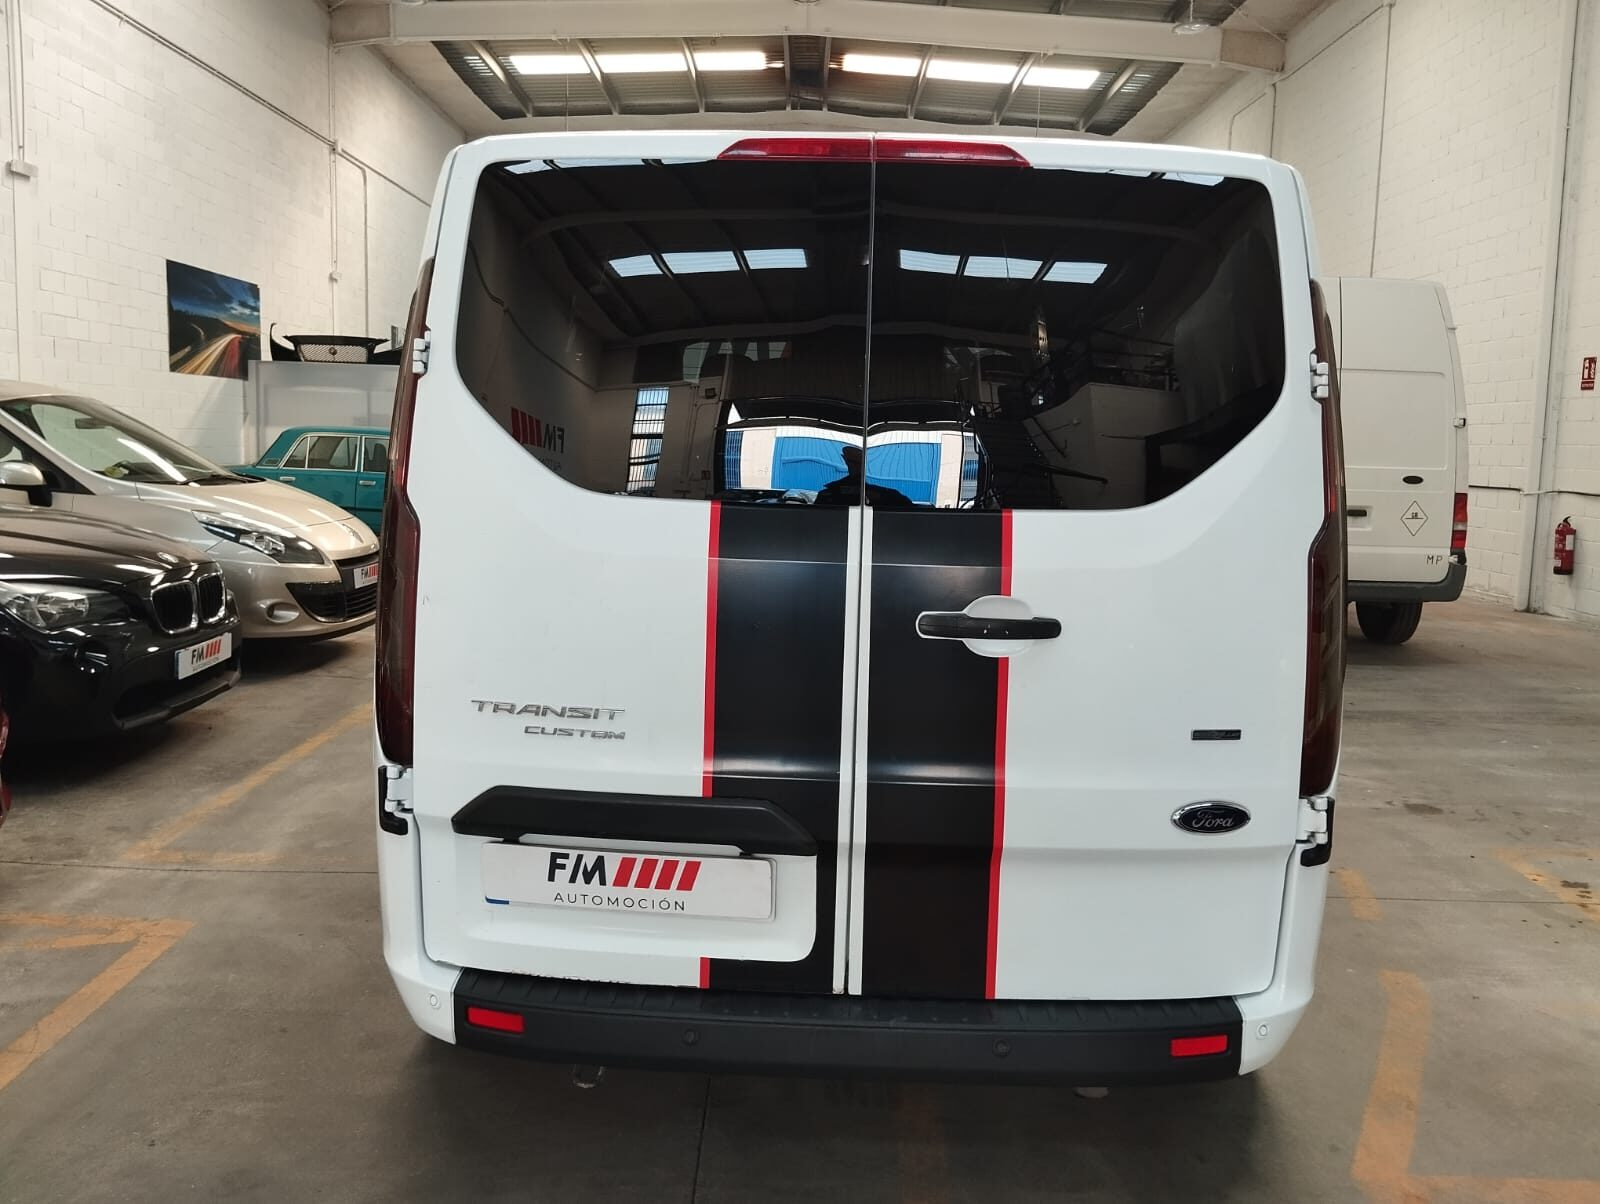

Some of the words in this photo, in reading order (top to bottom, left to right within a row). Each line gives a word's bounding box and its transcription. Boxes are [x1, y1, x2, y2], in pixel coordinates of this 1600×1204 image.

[191, 646, 204, 664] FM
[471, 700, 625, 720] TRANSIT
[524, 725, 625, 740] CUSTOM
[1192, 809, 1234, 828] Ford
[547, 851, 607, 886] FM
[553, 892, 686, 911] AUTOMOCIÓN
